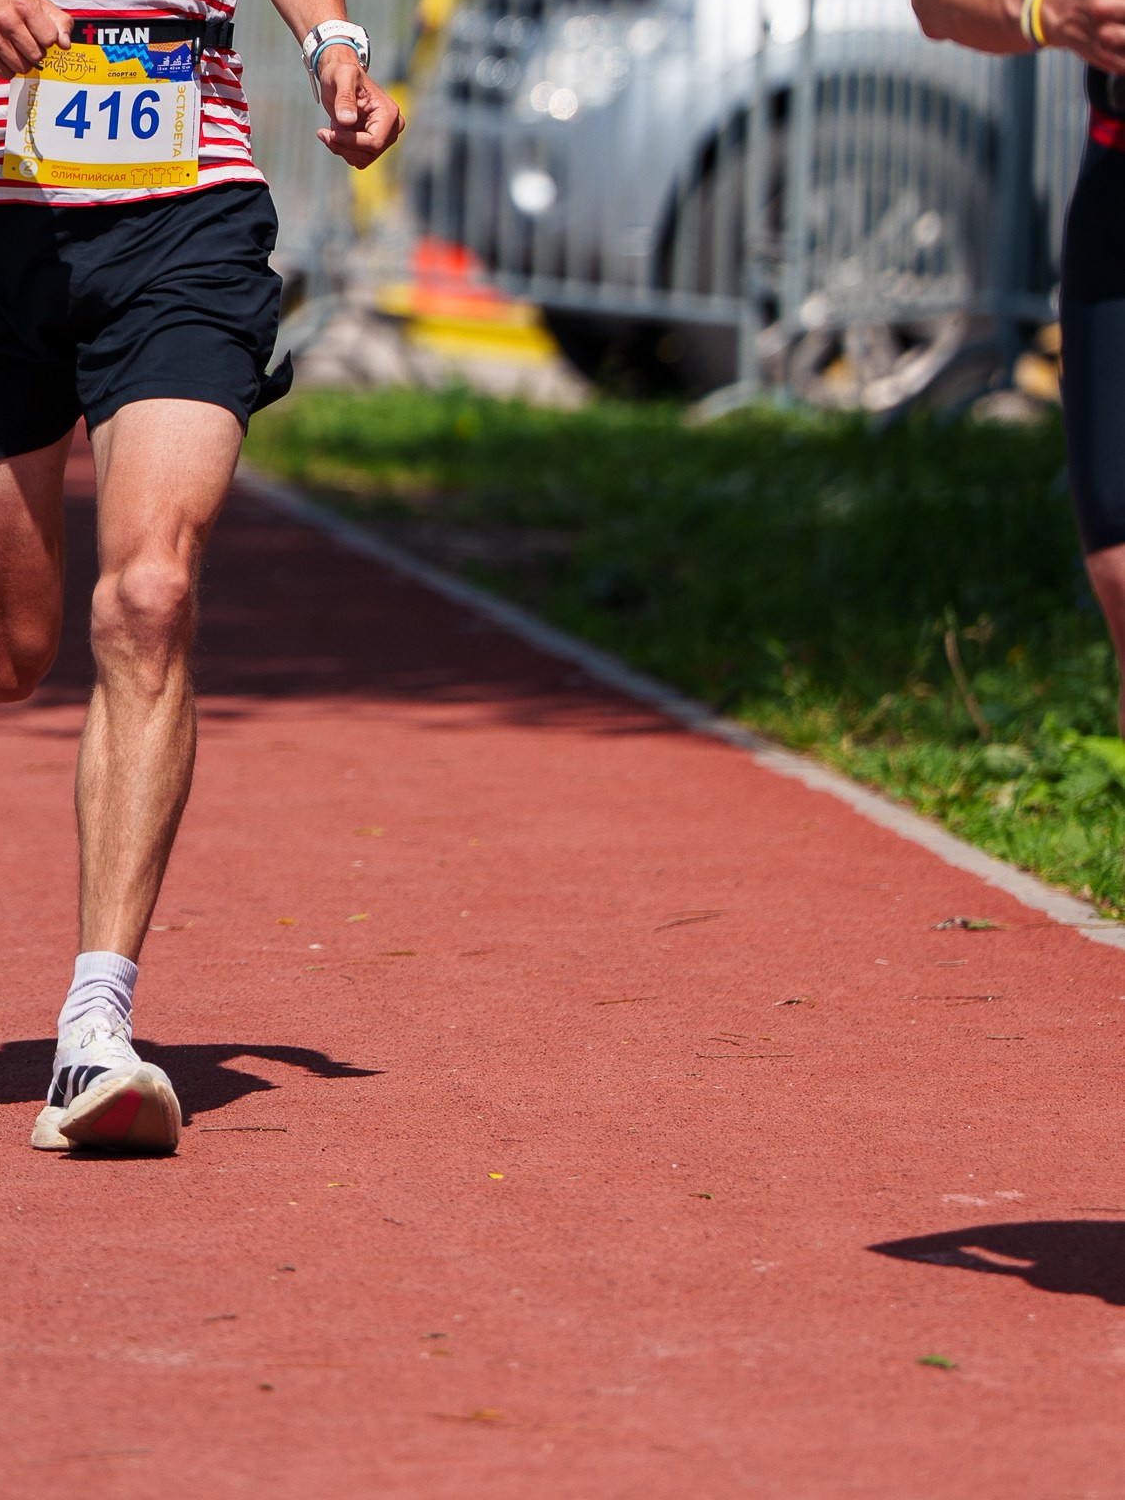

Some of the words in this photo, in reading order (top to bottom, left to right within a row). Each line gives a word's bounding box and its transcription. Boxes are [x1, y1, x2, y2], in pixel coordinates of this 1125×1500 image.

[82, 23, 150, 45] TITAN
[24, 82, 39, 154] ЭСТАФЕТА
[55, 89, 161, 140] 416
[172, 84, 187, 158] ЭСТАФЕТА
[51, 170, 127, 182] ОЛИМПИЙСКАЯ
